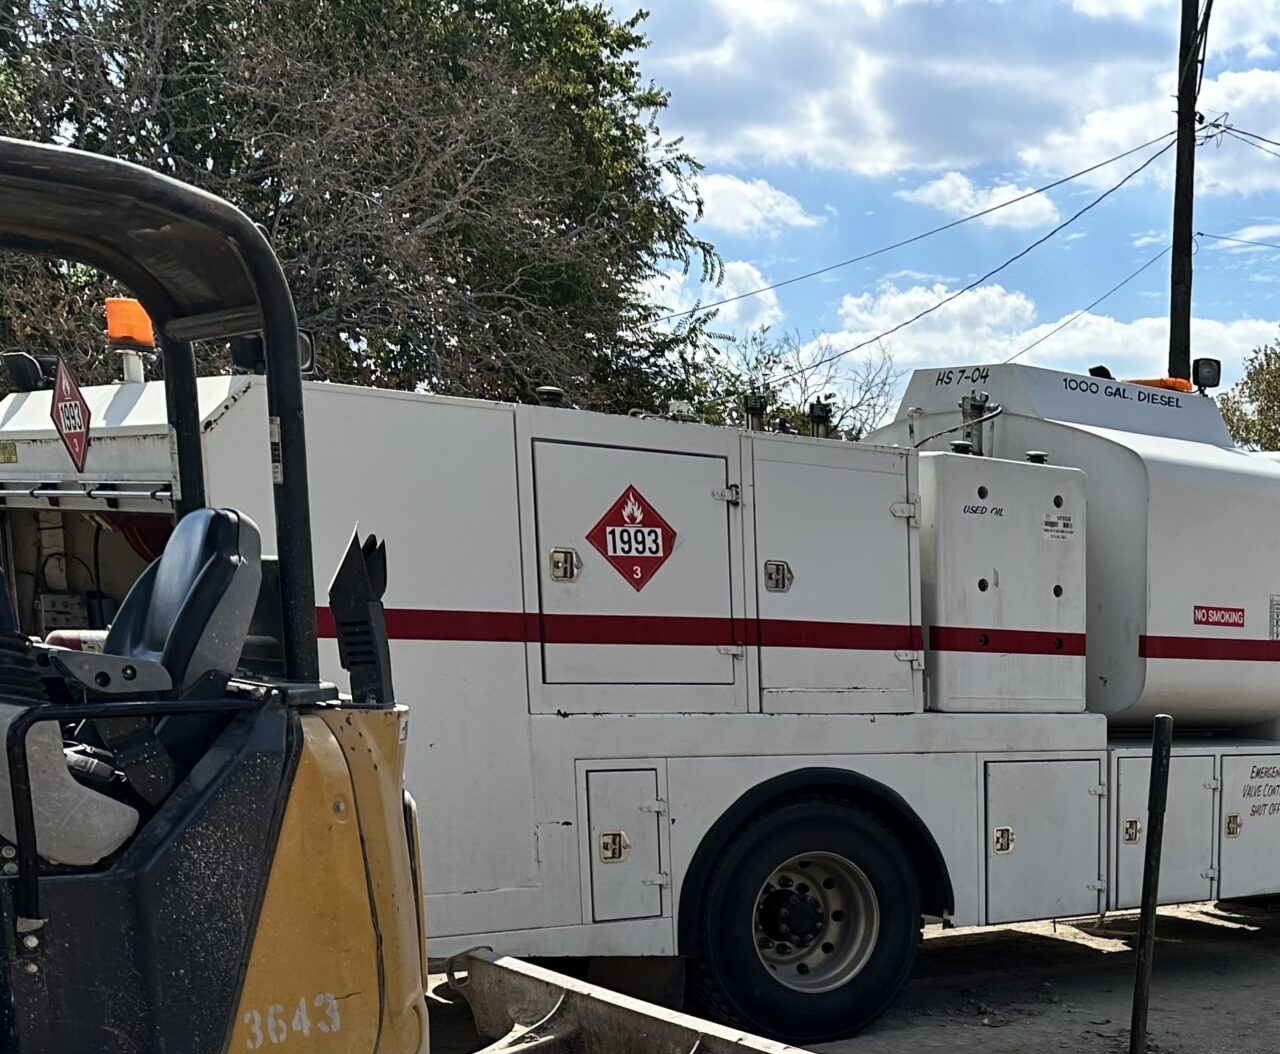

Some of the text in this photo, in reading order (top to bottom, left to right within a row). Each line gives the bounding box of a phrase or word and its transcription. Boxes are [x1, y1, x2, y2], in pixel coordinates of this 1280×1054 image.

[935, 367, 990, 386] HS 7-04
[1062, 377, 1183, 409] 1000 GAL. DIESEL
[60, 402, 83, 431] 1993
[962, 505, 988, 515] USED
[608, 528, 660, 555] 1993
[632, 565, 642, 579] 3
[1195, 608, 1244, 624] NO SMOKING
[1242, 784, 1262, 798] VALVE
[1250, 804, 1268, 817] SHUT
[243, 992, 341, 1050] 3643
